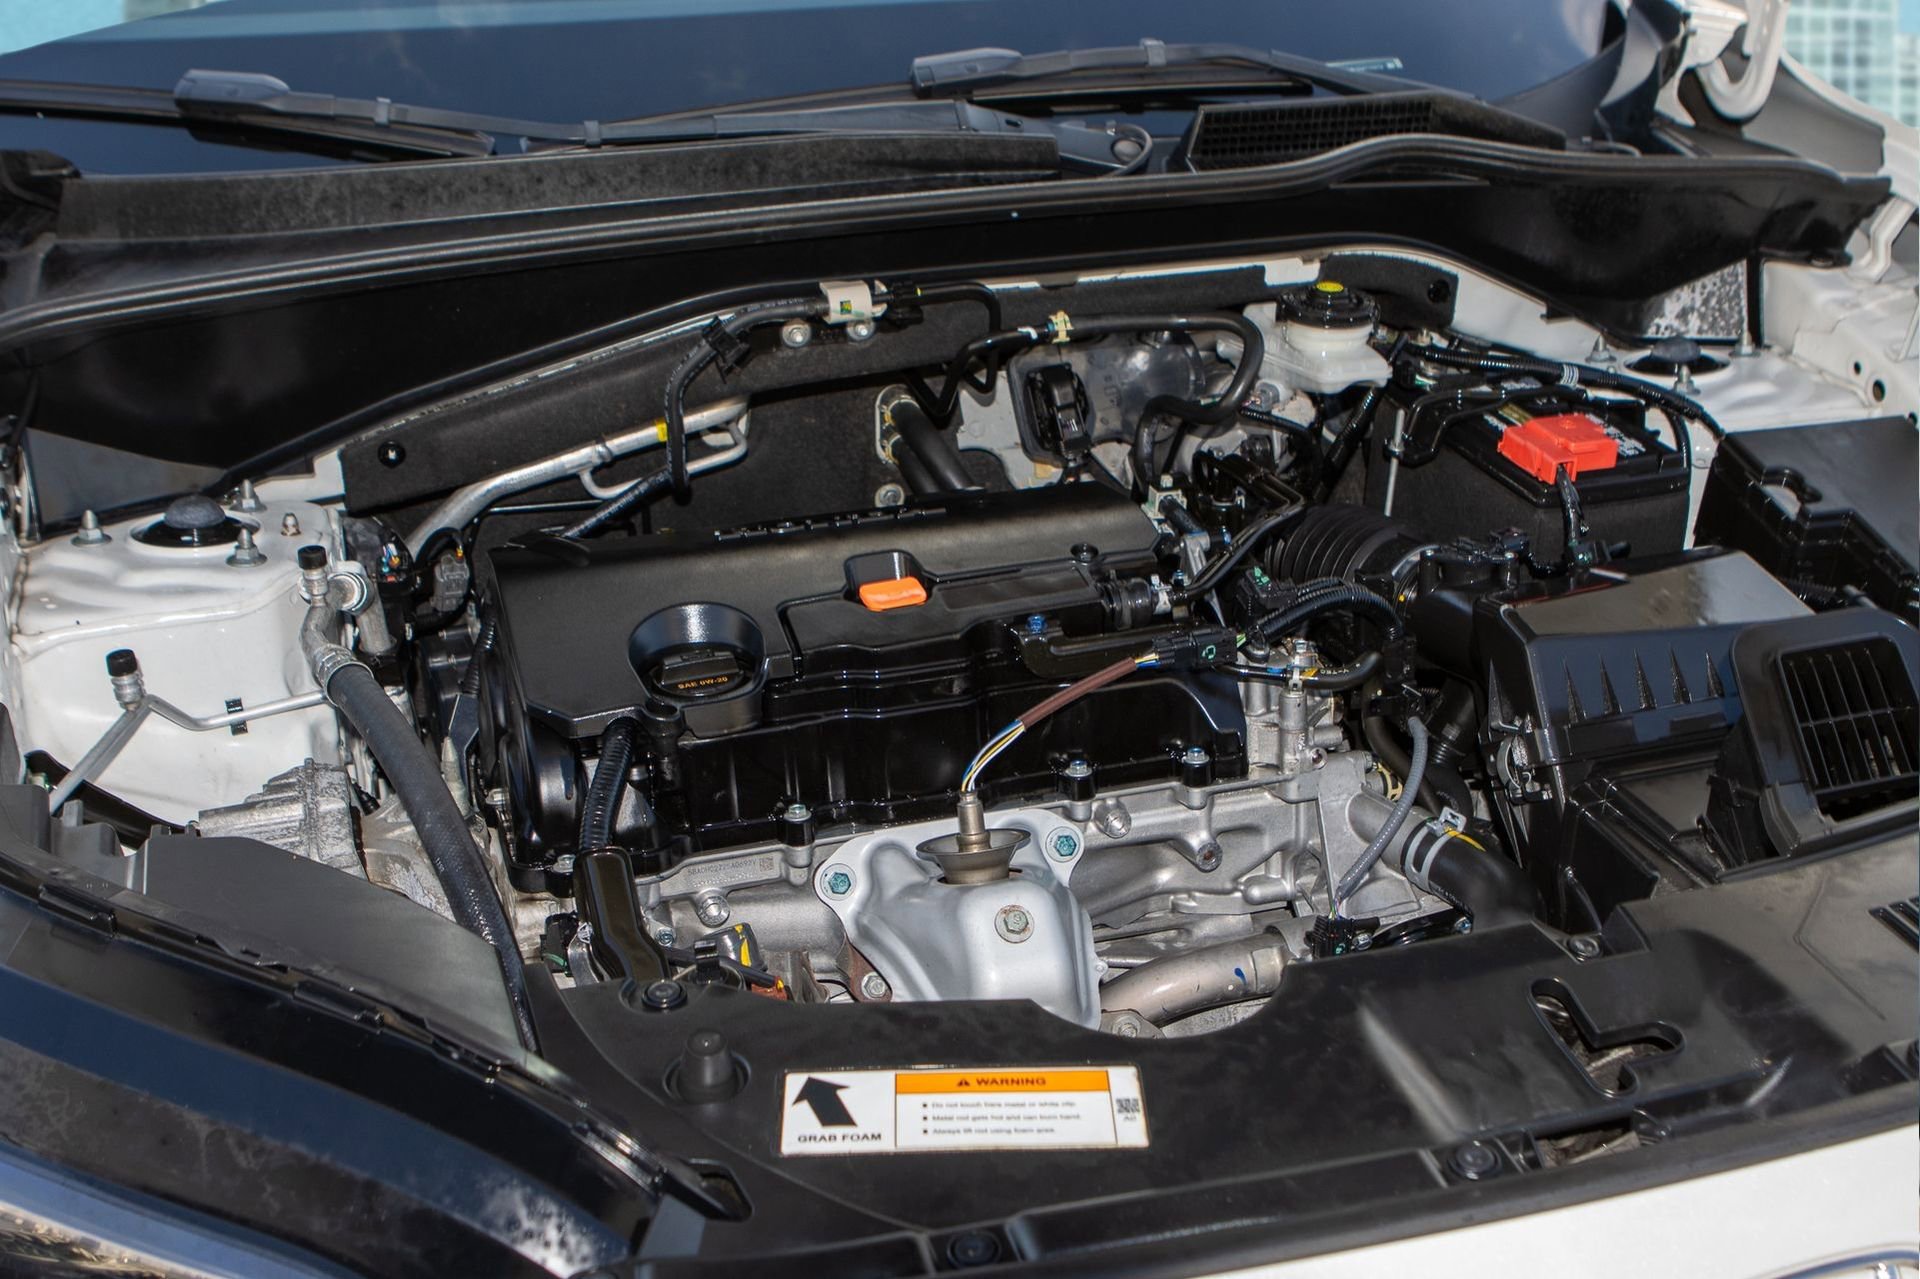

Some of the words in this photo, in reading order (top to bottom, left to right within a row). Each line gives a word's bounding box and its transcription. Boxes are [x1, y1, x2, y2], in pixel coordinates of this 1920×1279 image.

[976, 1077, 1047, 1086] WARNING
[797, 1134, 837, 1143] GRAB
[842, 1133, 881, 1141] FOAM
